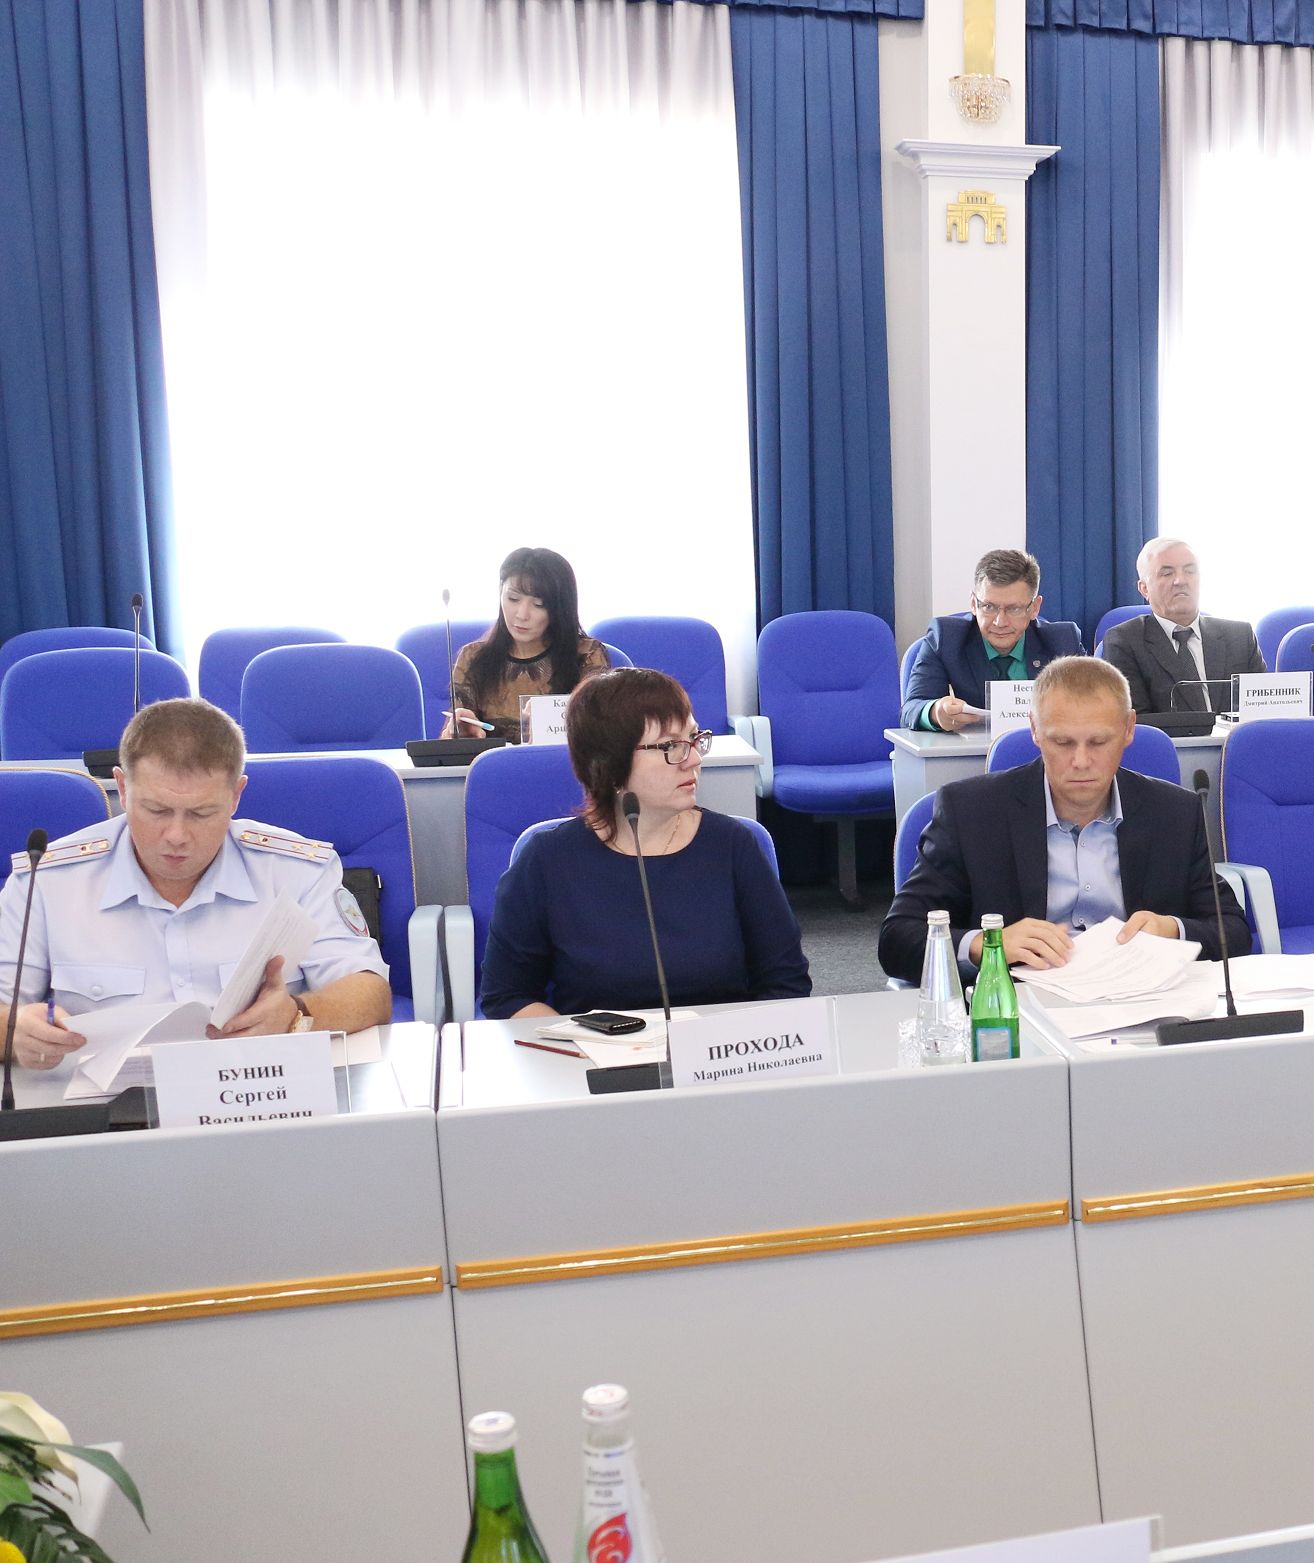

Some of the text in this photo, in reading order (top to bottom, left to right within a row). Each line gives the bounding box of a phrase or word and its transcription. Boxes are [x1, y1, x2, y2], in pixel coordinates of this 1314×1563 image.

[1246, 687, 1300, 697] ГРИБЕННИК
[708, 1033, 804, 1060] ПРОХОДА
[218, 1064, 284, 1082] БУНИН
[693, 1052, 823, 1082] Марина Николаевна
[219, 1086, 288, 1106] Сергей
